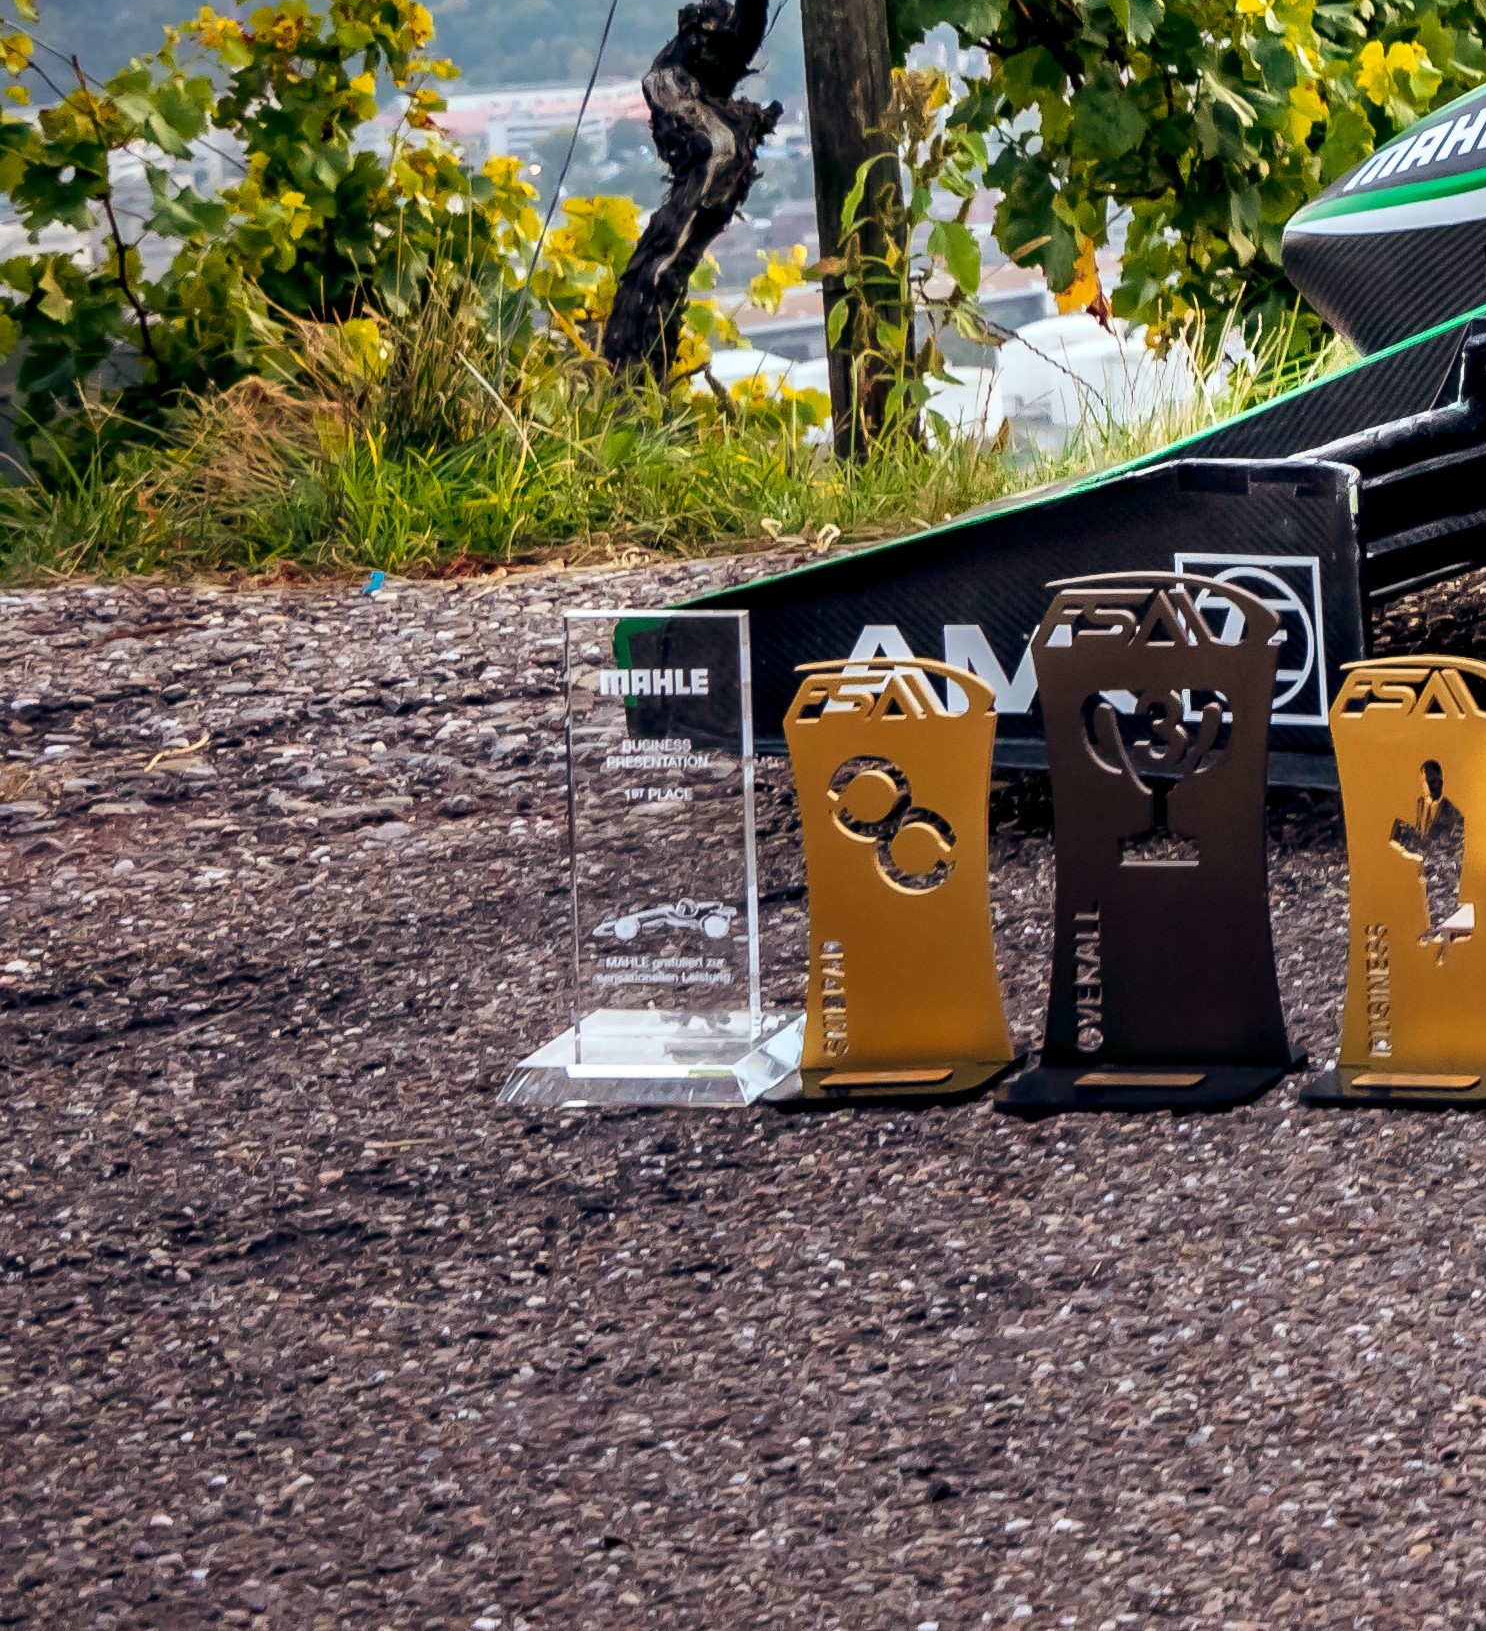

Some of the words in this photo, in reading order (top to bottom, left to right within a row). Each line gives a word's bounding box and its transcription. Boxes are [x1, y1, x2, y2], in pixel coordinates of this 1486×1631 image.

[600, 668, 709, 696] MAHLE
[621, 738, 692, 754] BUSINESS
[606, 755, 710, 769] PRESENTATION
[648, 787, 693, 802] PLACE
[1072, 901, 1104, 1053] OVERALL
